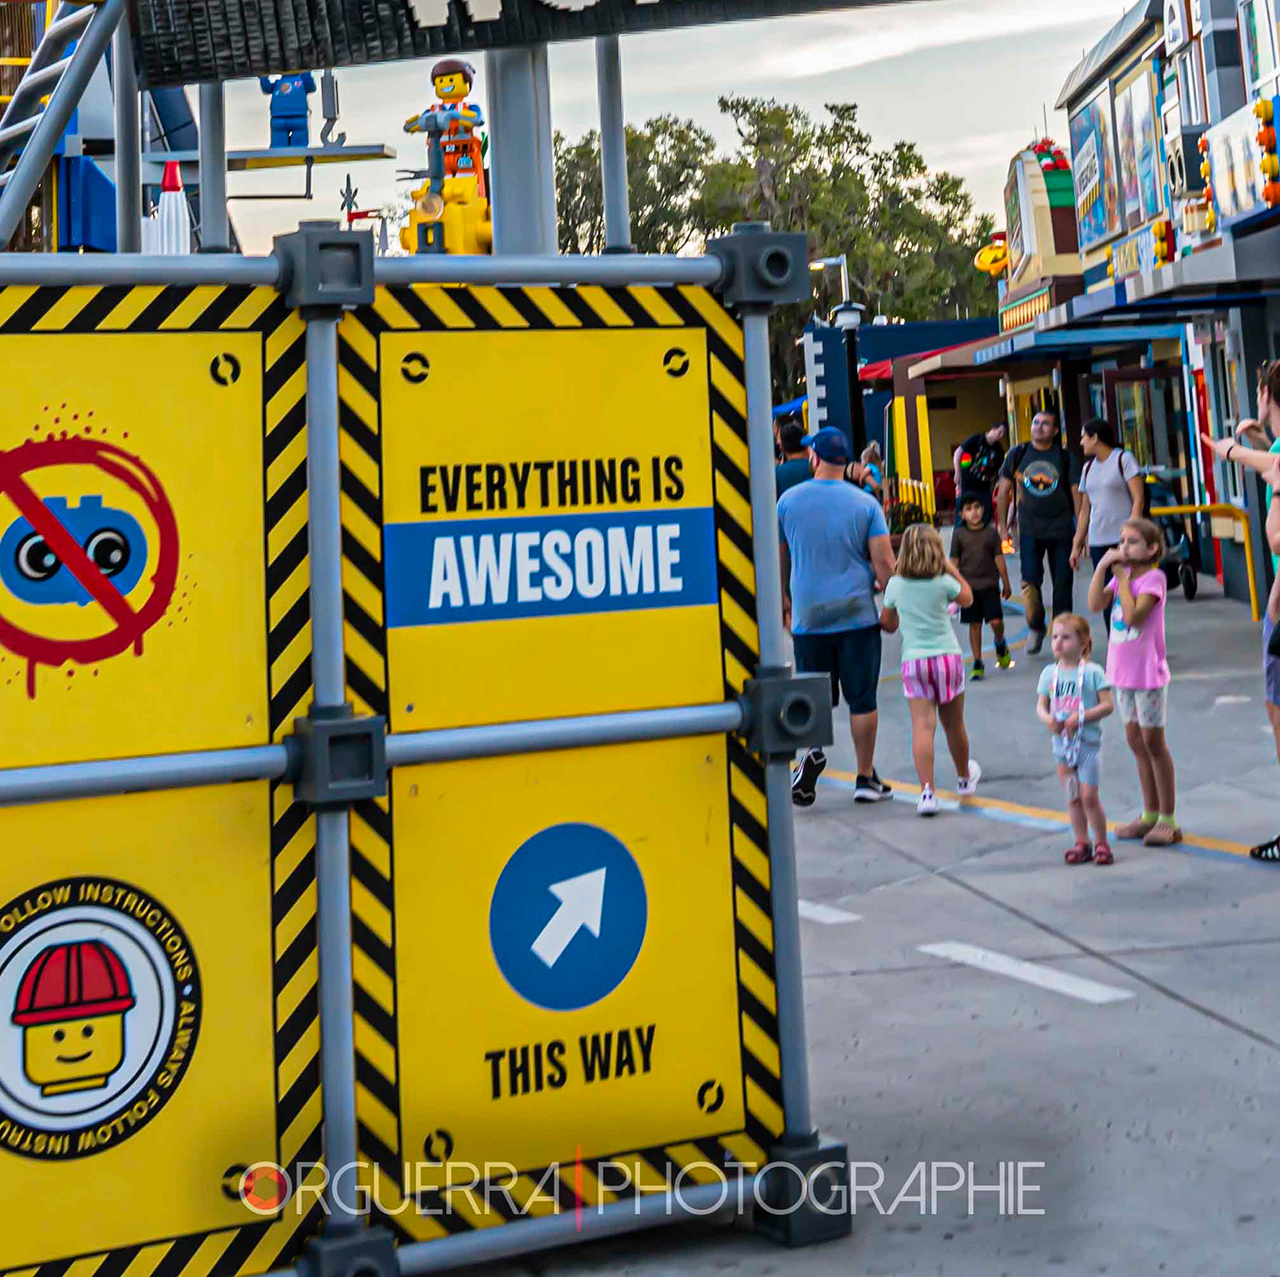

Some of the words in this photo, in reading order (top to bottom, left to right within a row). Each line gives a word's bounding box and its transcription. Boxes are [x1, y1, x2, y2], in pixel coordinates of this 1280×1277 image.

[419, 457, 641, 514] EVERYTHING
[651, 455, 685, 502] IS
[428, 523, 683, 609] AWESOME
[78, 882, 194, 983] INSTRUCTIONS
[156, 1000, 197, 1089] ALWAYS
[485, 1039, 567, 1101] THIS
[581, 1024, 657, 1083] WAY
[77, 1089, 160, 1152] FOLLOW
